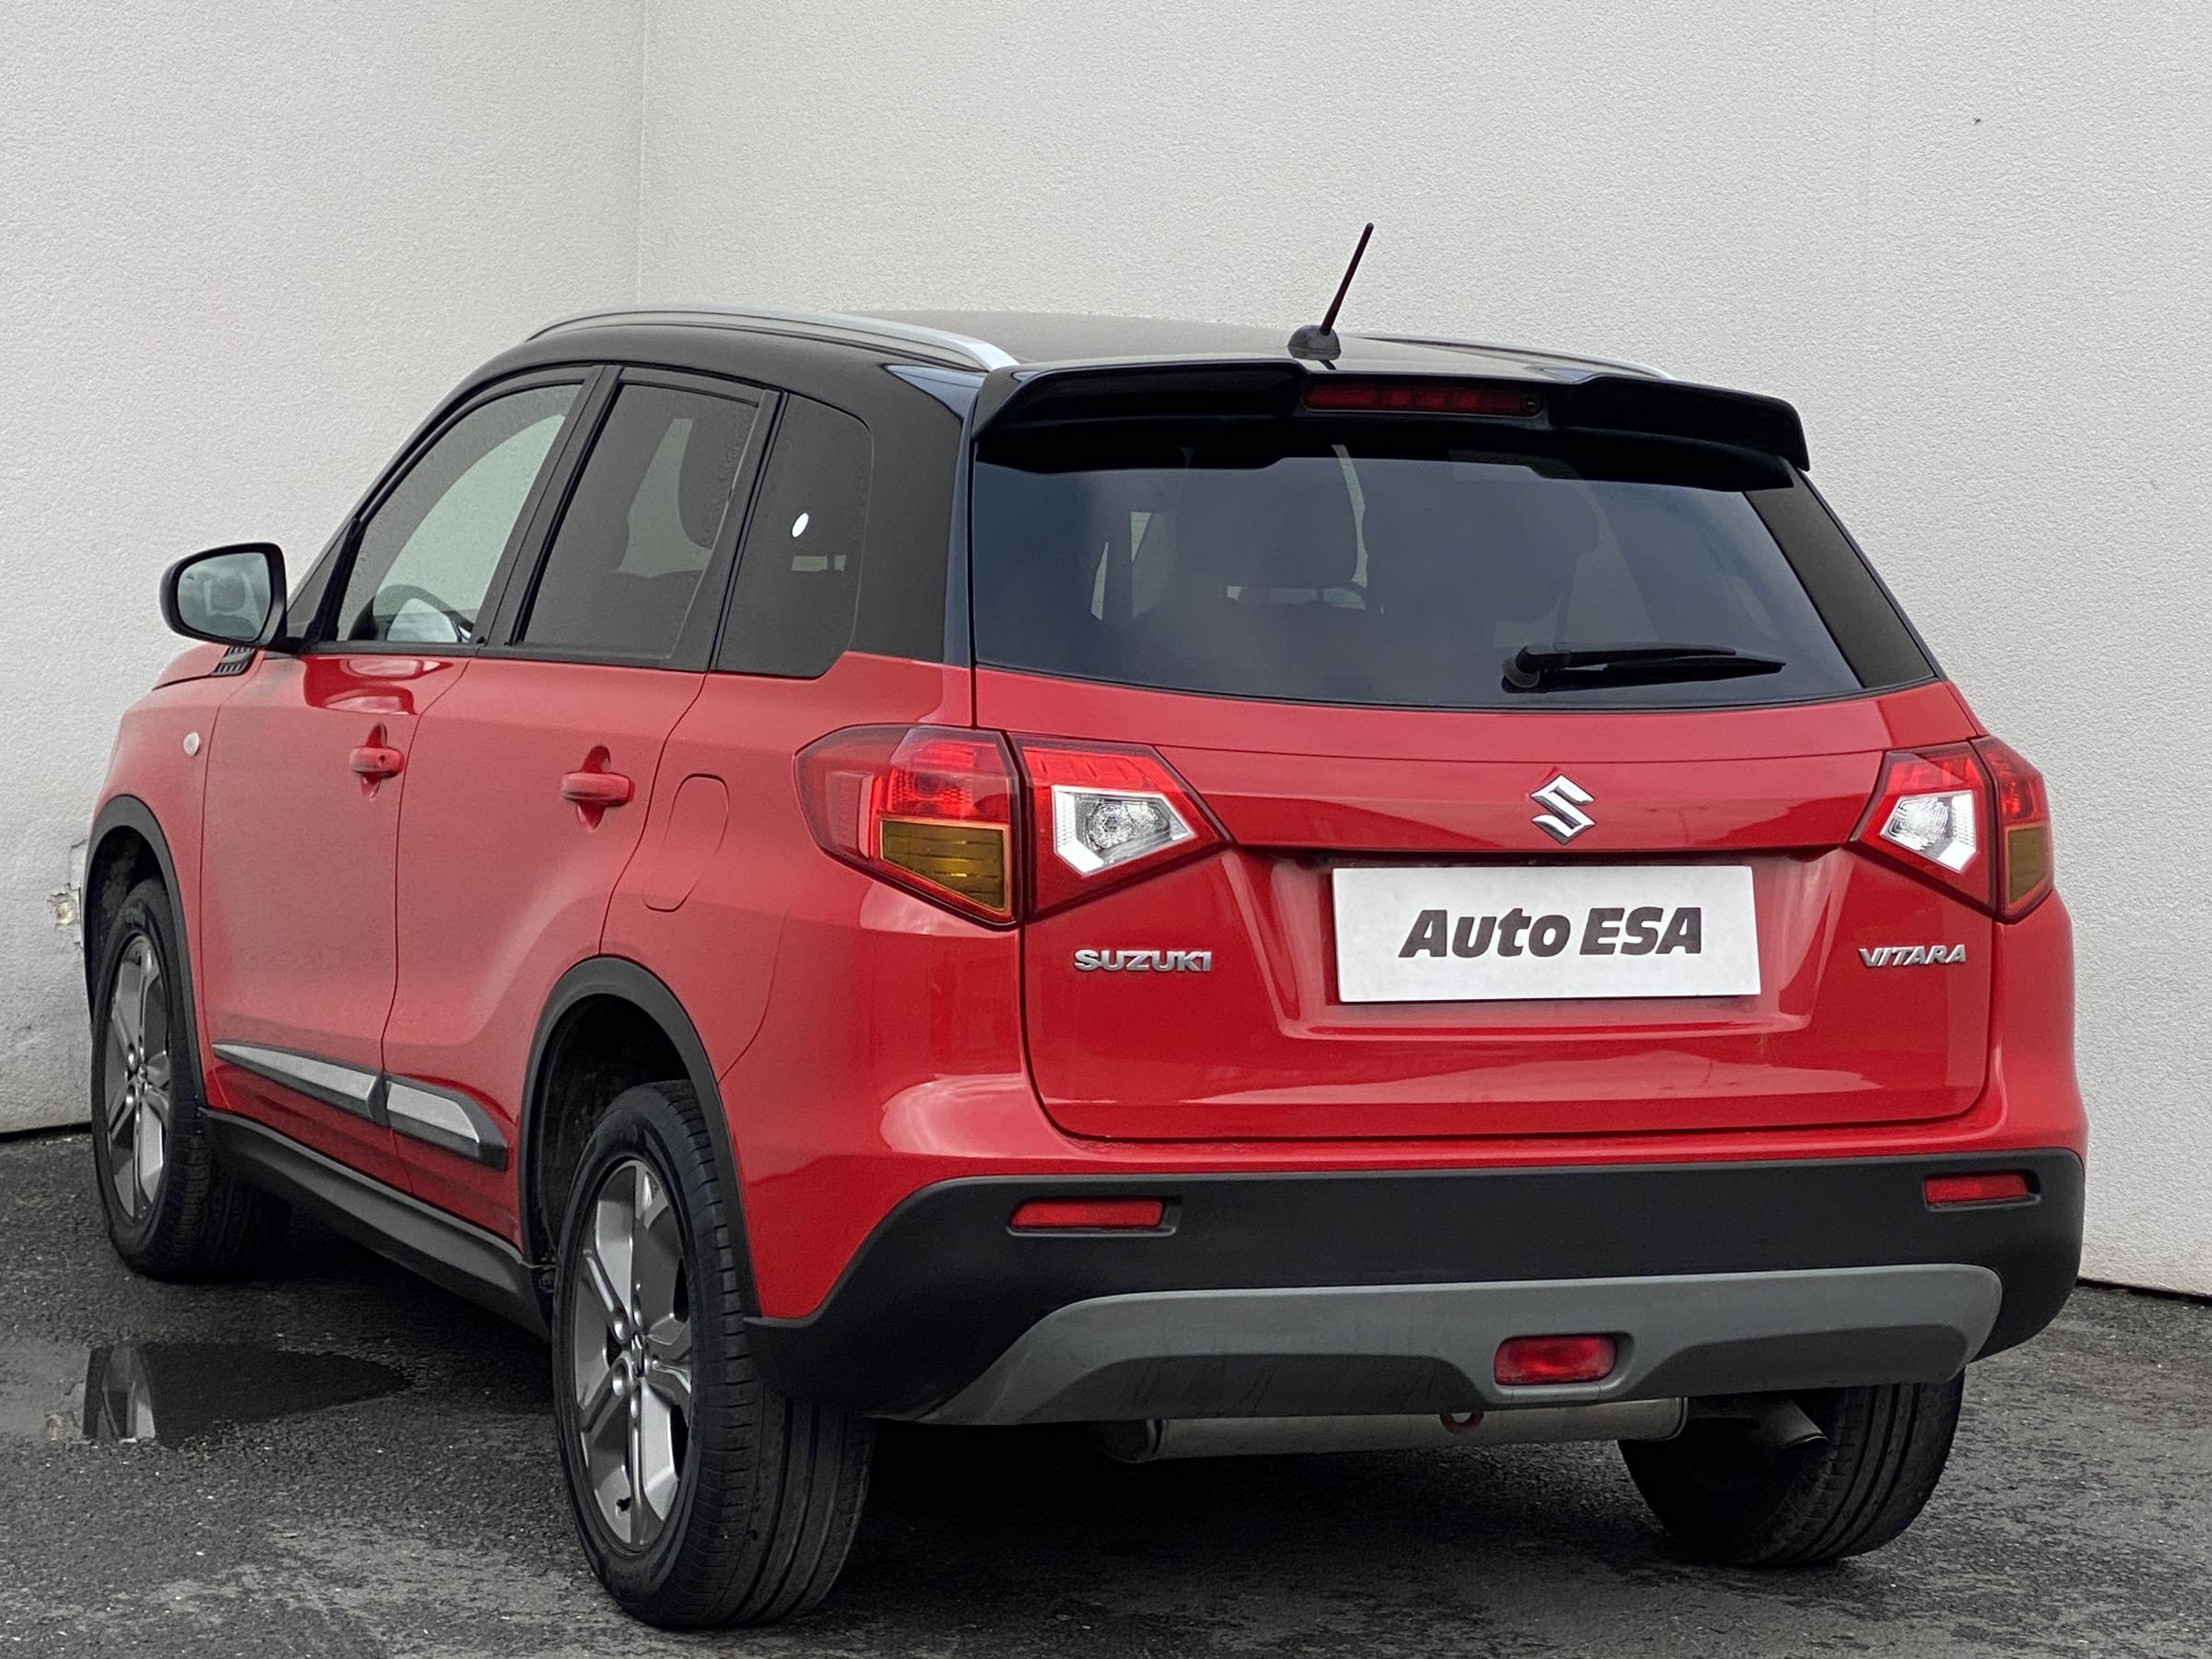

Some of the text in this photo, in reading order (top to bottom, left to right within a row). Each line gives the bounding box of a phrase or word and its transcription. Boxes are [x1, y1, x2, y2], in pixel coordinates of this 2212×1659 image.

[1397, 906, 1703, 959] Auto ESA
[1074, 948, 1213, 972] SUZUKI
[1857, 943, 1967, 968] VITARA
